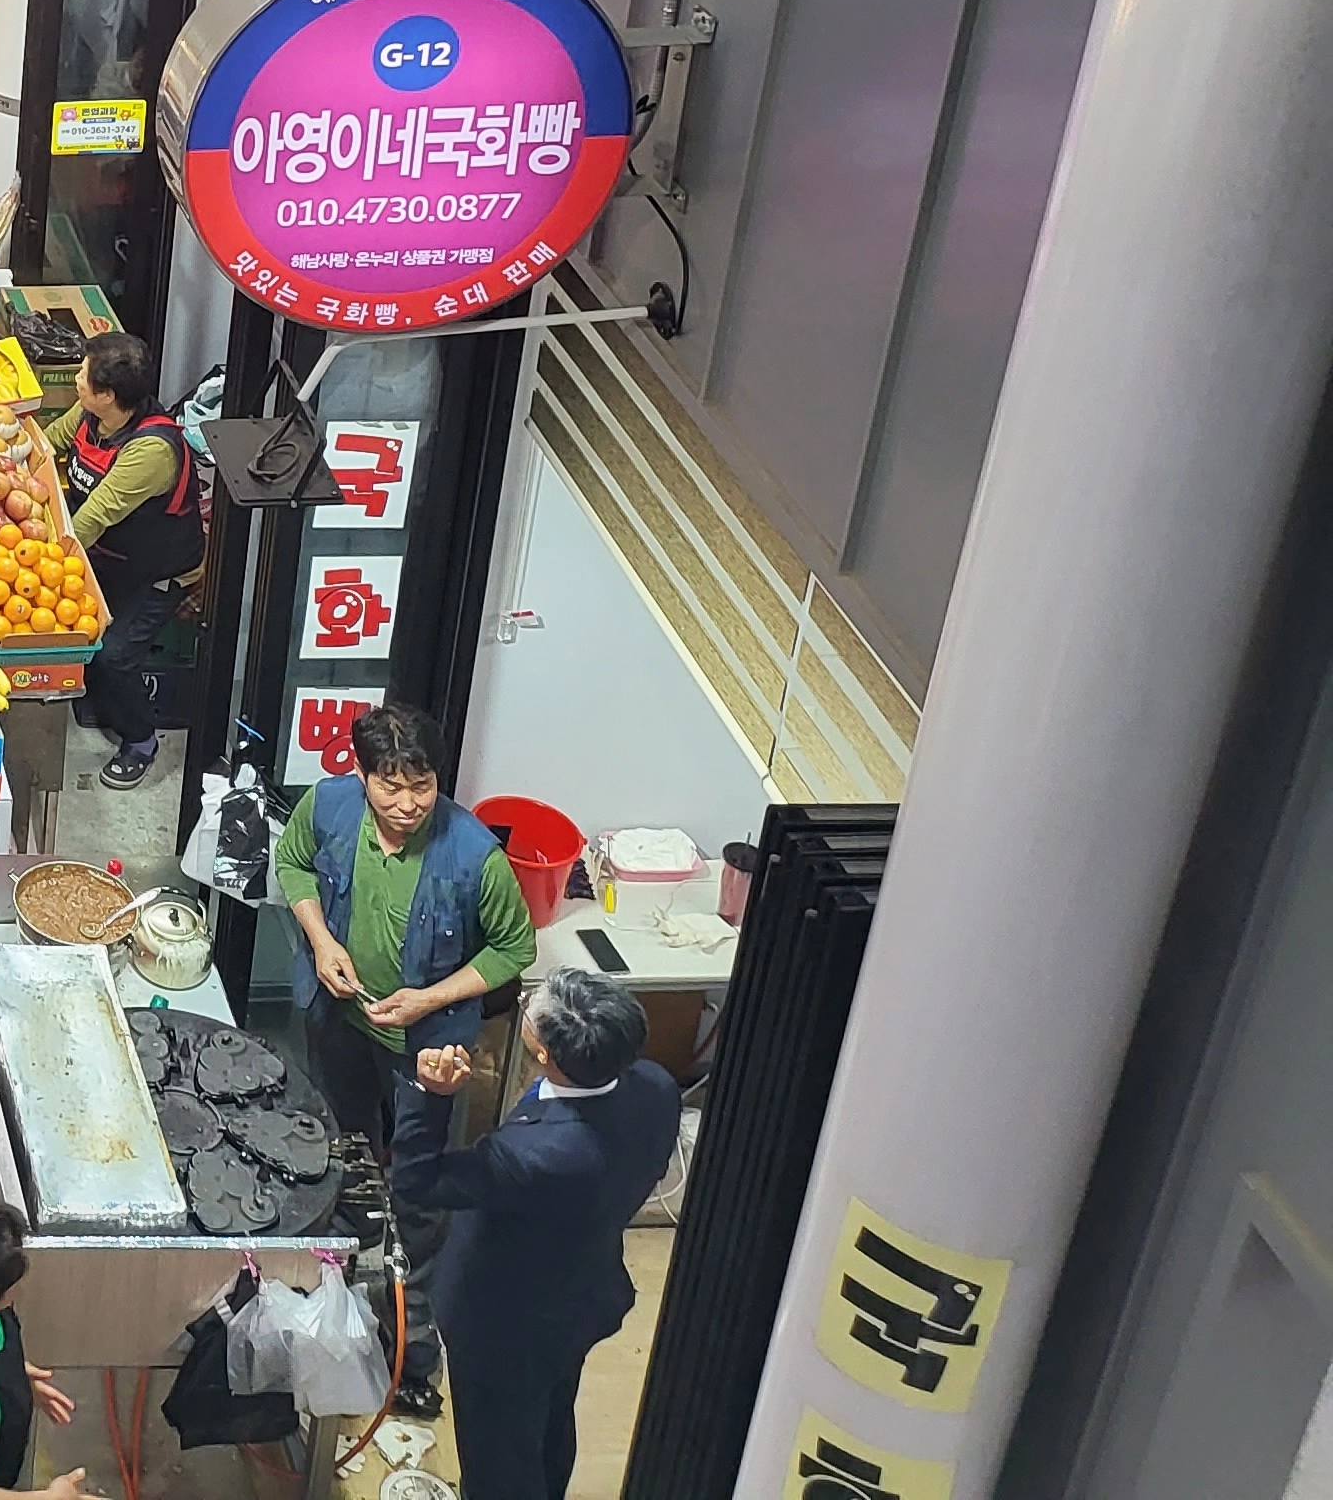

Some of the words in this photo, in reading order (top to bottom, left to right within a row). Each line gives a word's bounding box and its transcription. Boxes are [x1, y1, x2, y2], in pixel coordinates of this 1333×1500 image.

[380, 42, 451, 67] G-12
[71, 126, 136, 135] 010-3631-3747
[234, 101, 580, 185] 아영이네국화빵
[276, 192, 521, 228] 010.4730.0877
[402, 248, 446, 267] 상품권
[449, 247, 494, 265] 가맹점
[229, 250, 300, 306] 맛있는
[434, 281, 490, 316] 순대
[501, 241, 558, 286] 판매
